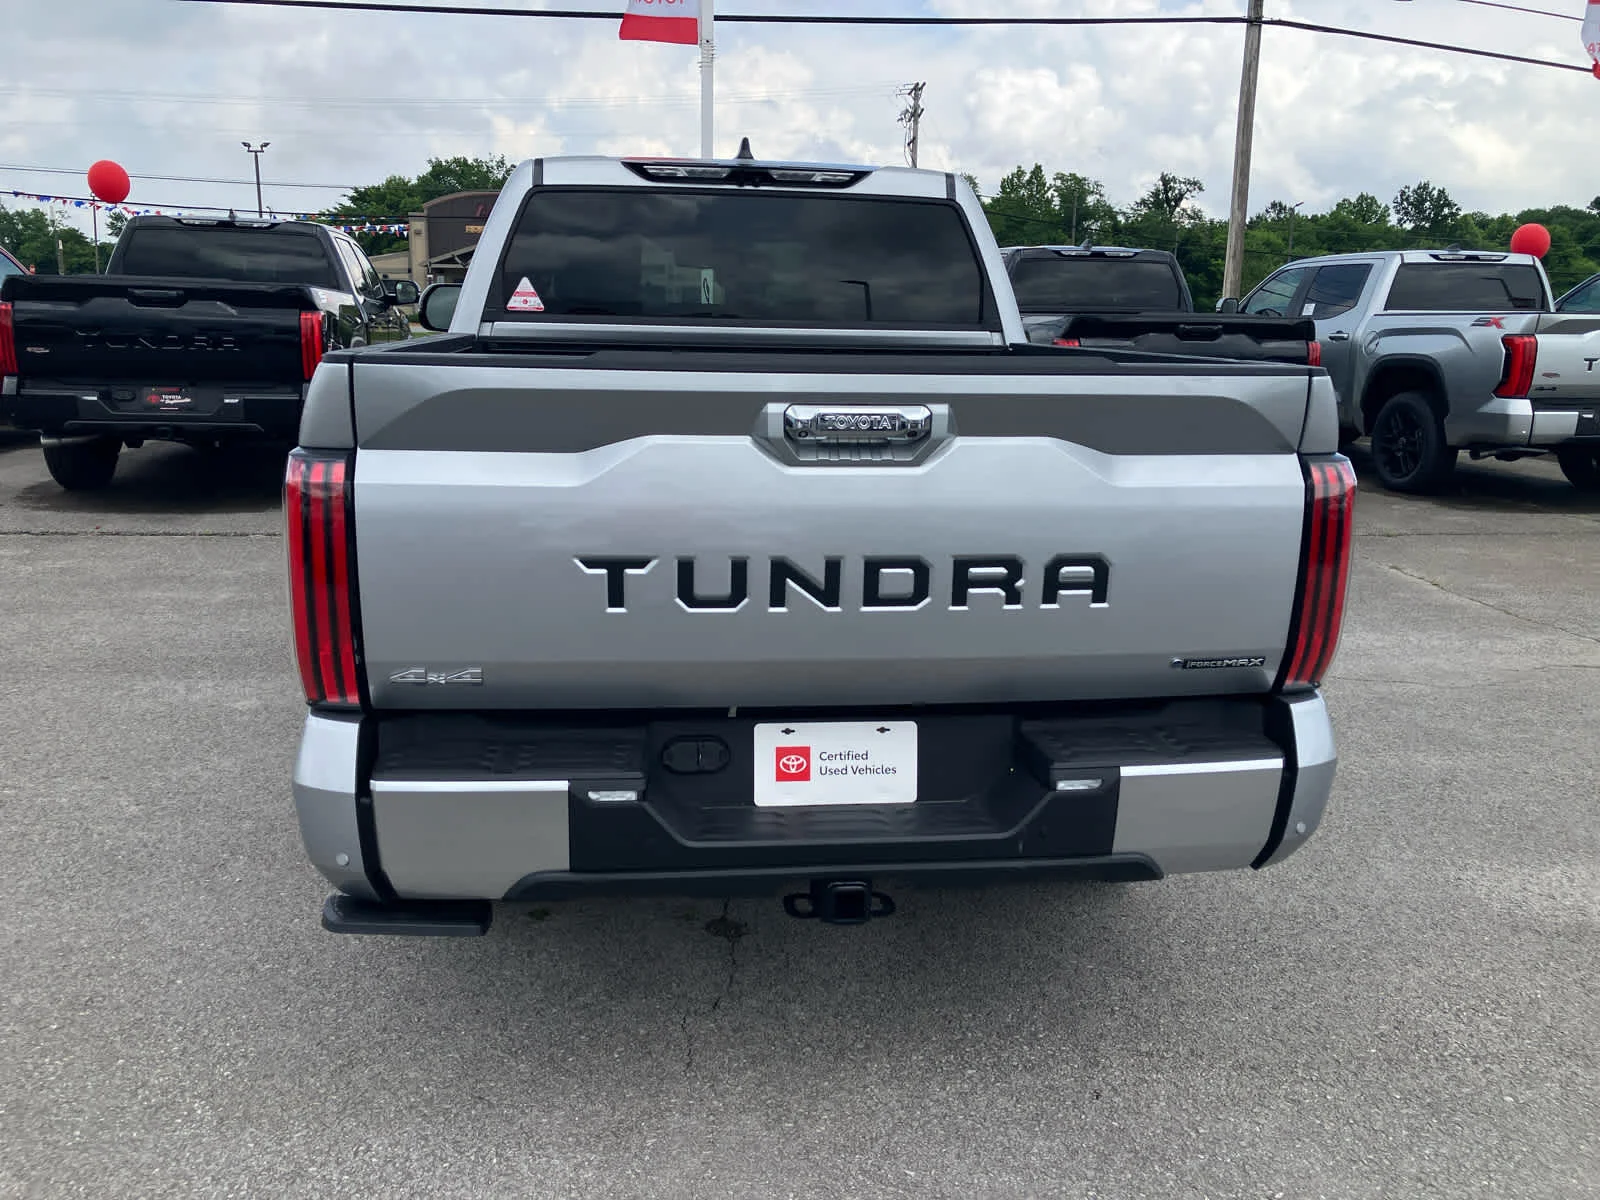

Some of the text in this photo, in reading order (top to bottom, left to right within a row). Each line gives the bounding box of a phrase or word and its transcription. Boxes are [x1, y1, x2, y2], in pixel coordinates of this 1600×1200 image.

[825, 414, 892, 430] TOYOTA
[572, 552, 1112, 614] TUNDRA
[819, 750, 869, 761] Certified
[819, 764, 897, 776] Used Vehicles
